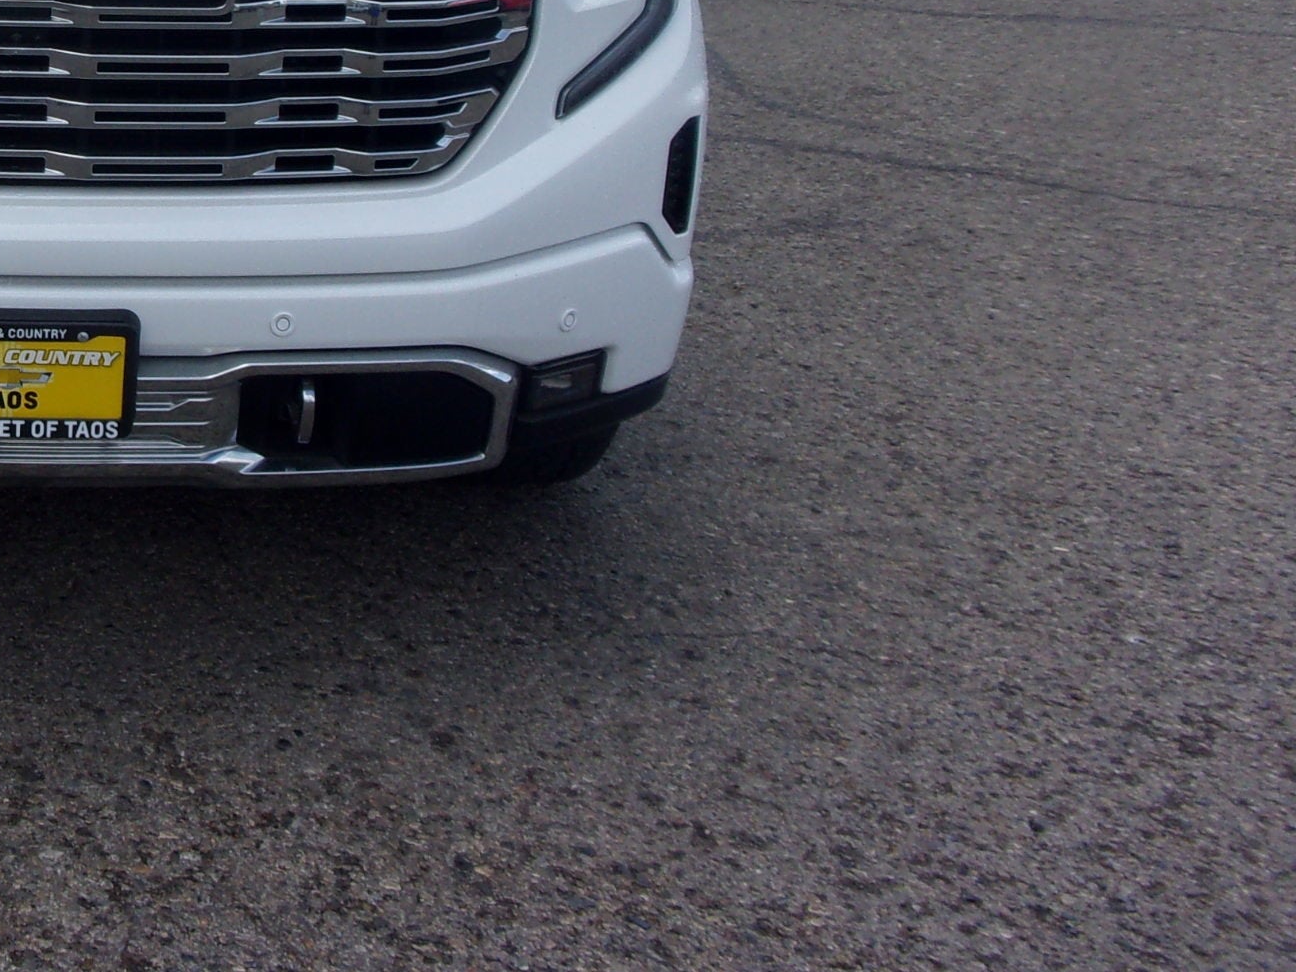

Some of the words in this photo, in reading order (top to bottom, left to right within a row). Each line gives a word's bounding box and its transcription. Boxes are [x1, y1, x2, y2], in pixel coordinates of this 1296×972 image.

[7, 328, 68, 340] COUNTRY
[4, 349, 121, 367] COUNTRY
[31, 420, 58, 438] OF
[64, 421, 119, 439] TAOS
